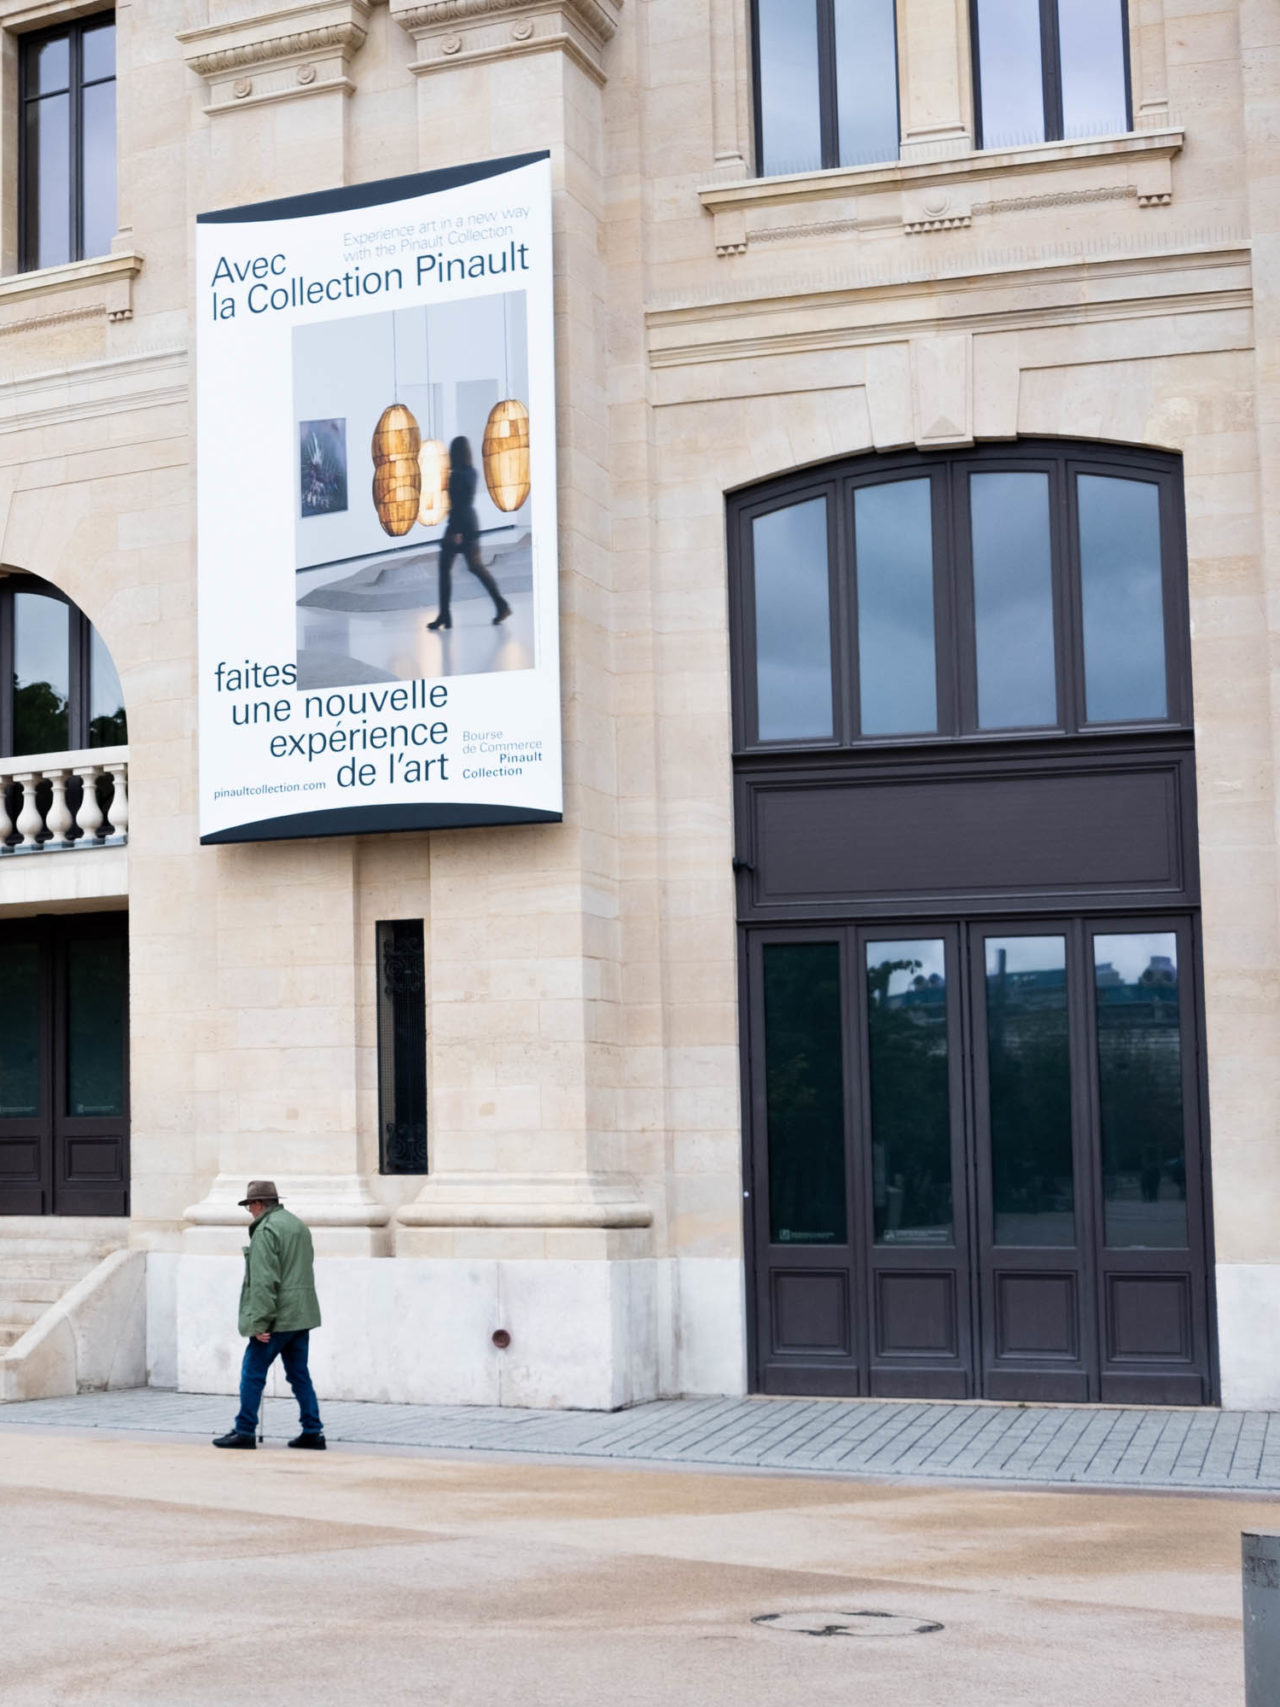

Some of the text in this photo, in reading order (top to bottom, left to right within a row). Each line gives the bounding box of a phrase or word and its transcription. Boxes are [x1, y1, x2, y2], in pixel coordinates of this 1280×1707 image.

[343, 204, 530, 247] Experience art in a new way
[343, 224, 513, 263] with the Pinault Collection
[210, 253, 288, 288] Avec
[213, 240, 530, 321] la Collection Pinault
[213, 659, 298, 693] faites
[232, 678, 449, 726] une nouvelle
[269, 720, 449, 763] expérience
[462, 731, 503, 742] Bourse
[462, 740, 543, 754] de Commerce
[336, 752, 449, 788] de l'art
[462, 766, 523, 779] Collection
[500, 751, 543, 763] Pinault
[214, 780, 326, 800] pinaultcollection.com
